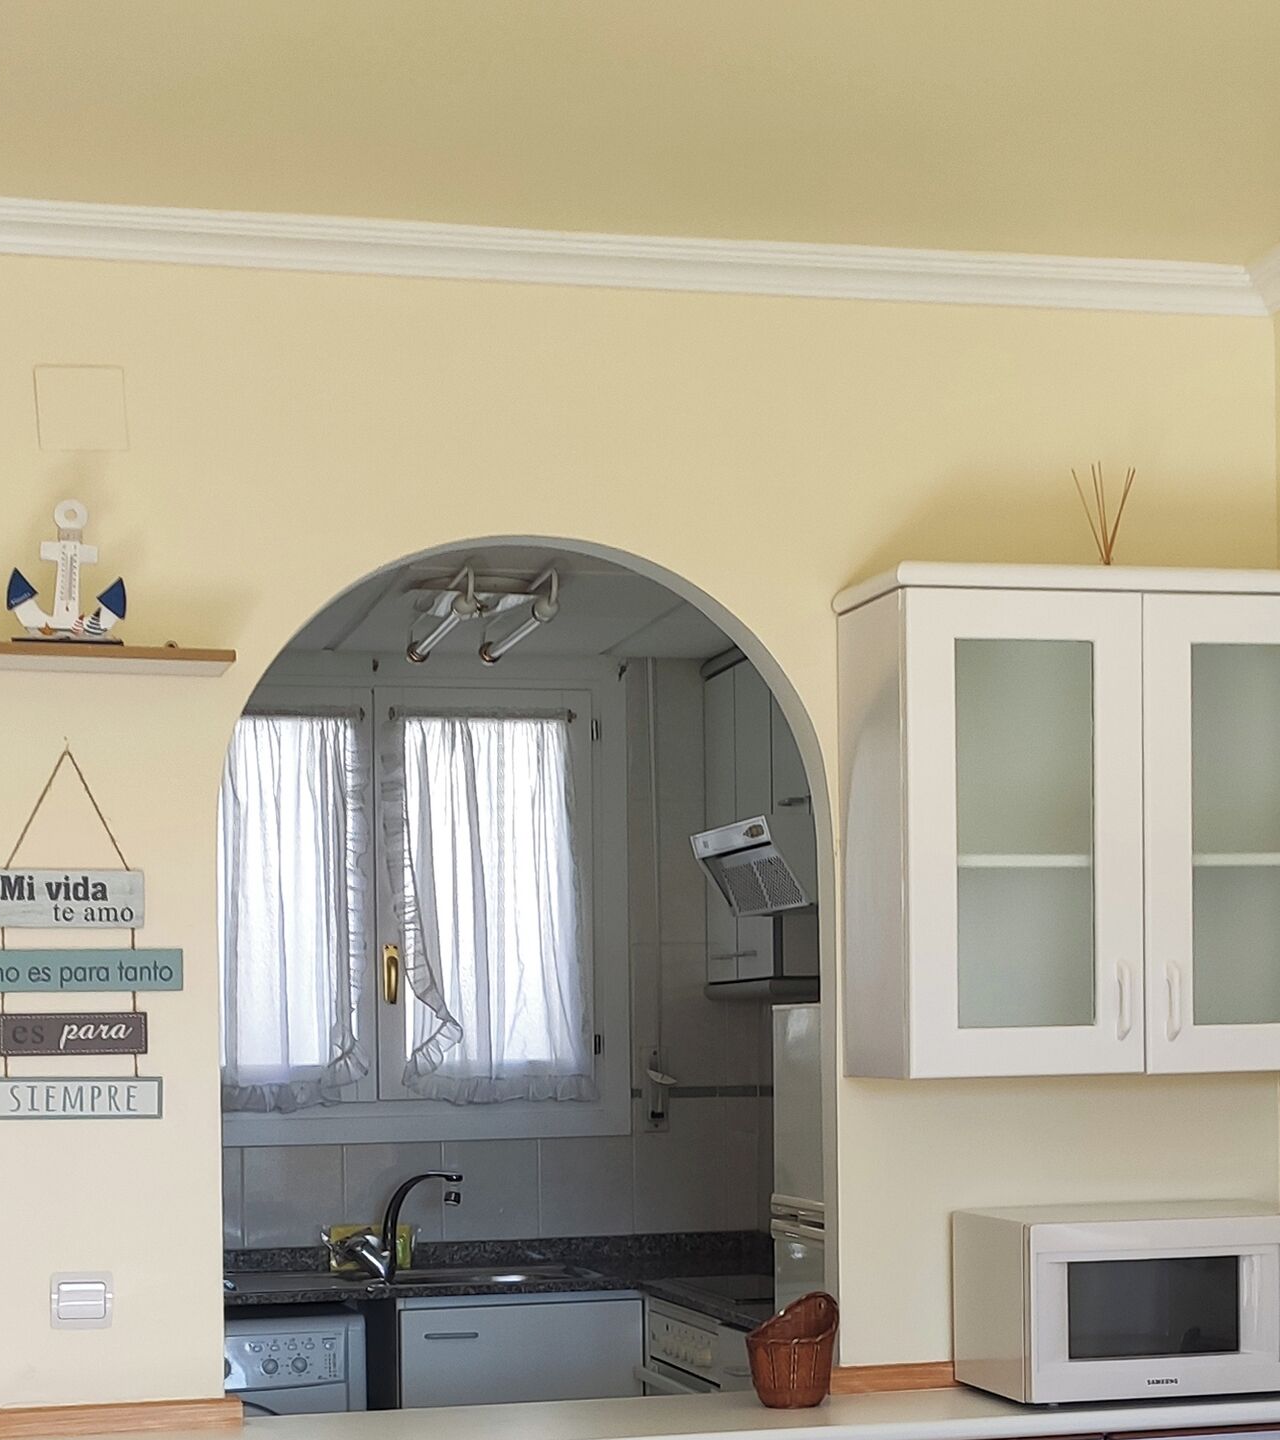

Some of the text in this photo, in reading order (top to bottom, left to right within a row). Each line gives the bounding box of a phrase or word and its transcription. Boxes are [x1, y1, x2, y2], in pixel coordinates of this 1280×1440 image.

[0, 875, 108, 901] Mi vida
[53, 905, 134, 922] te amo
[28, 965, 51, 983] es
[60, 964, 109, 988] para
[118, 960, 173, 982] tanto
[12, 1021, 133, 1049] es para
[9, 1085, 138, 1112] SIEMPRE
[1147, 1378, 1179, 1386] SAMSUNG
